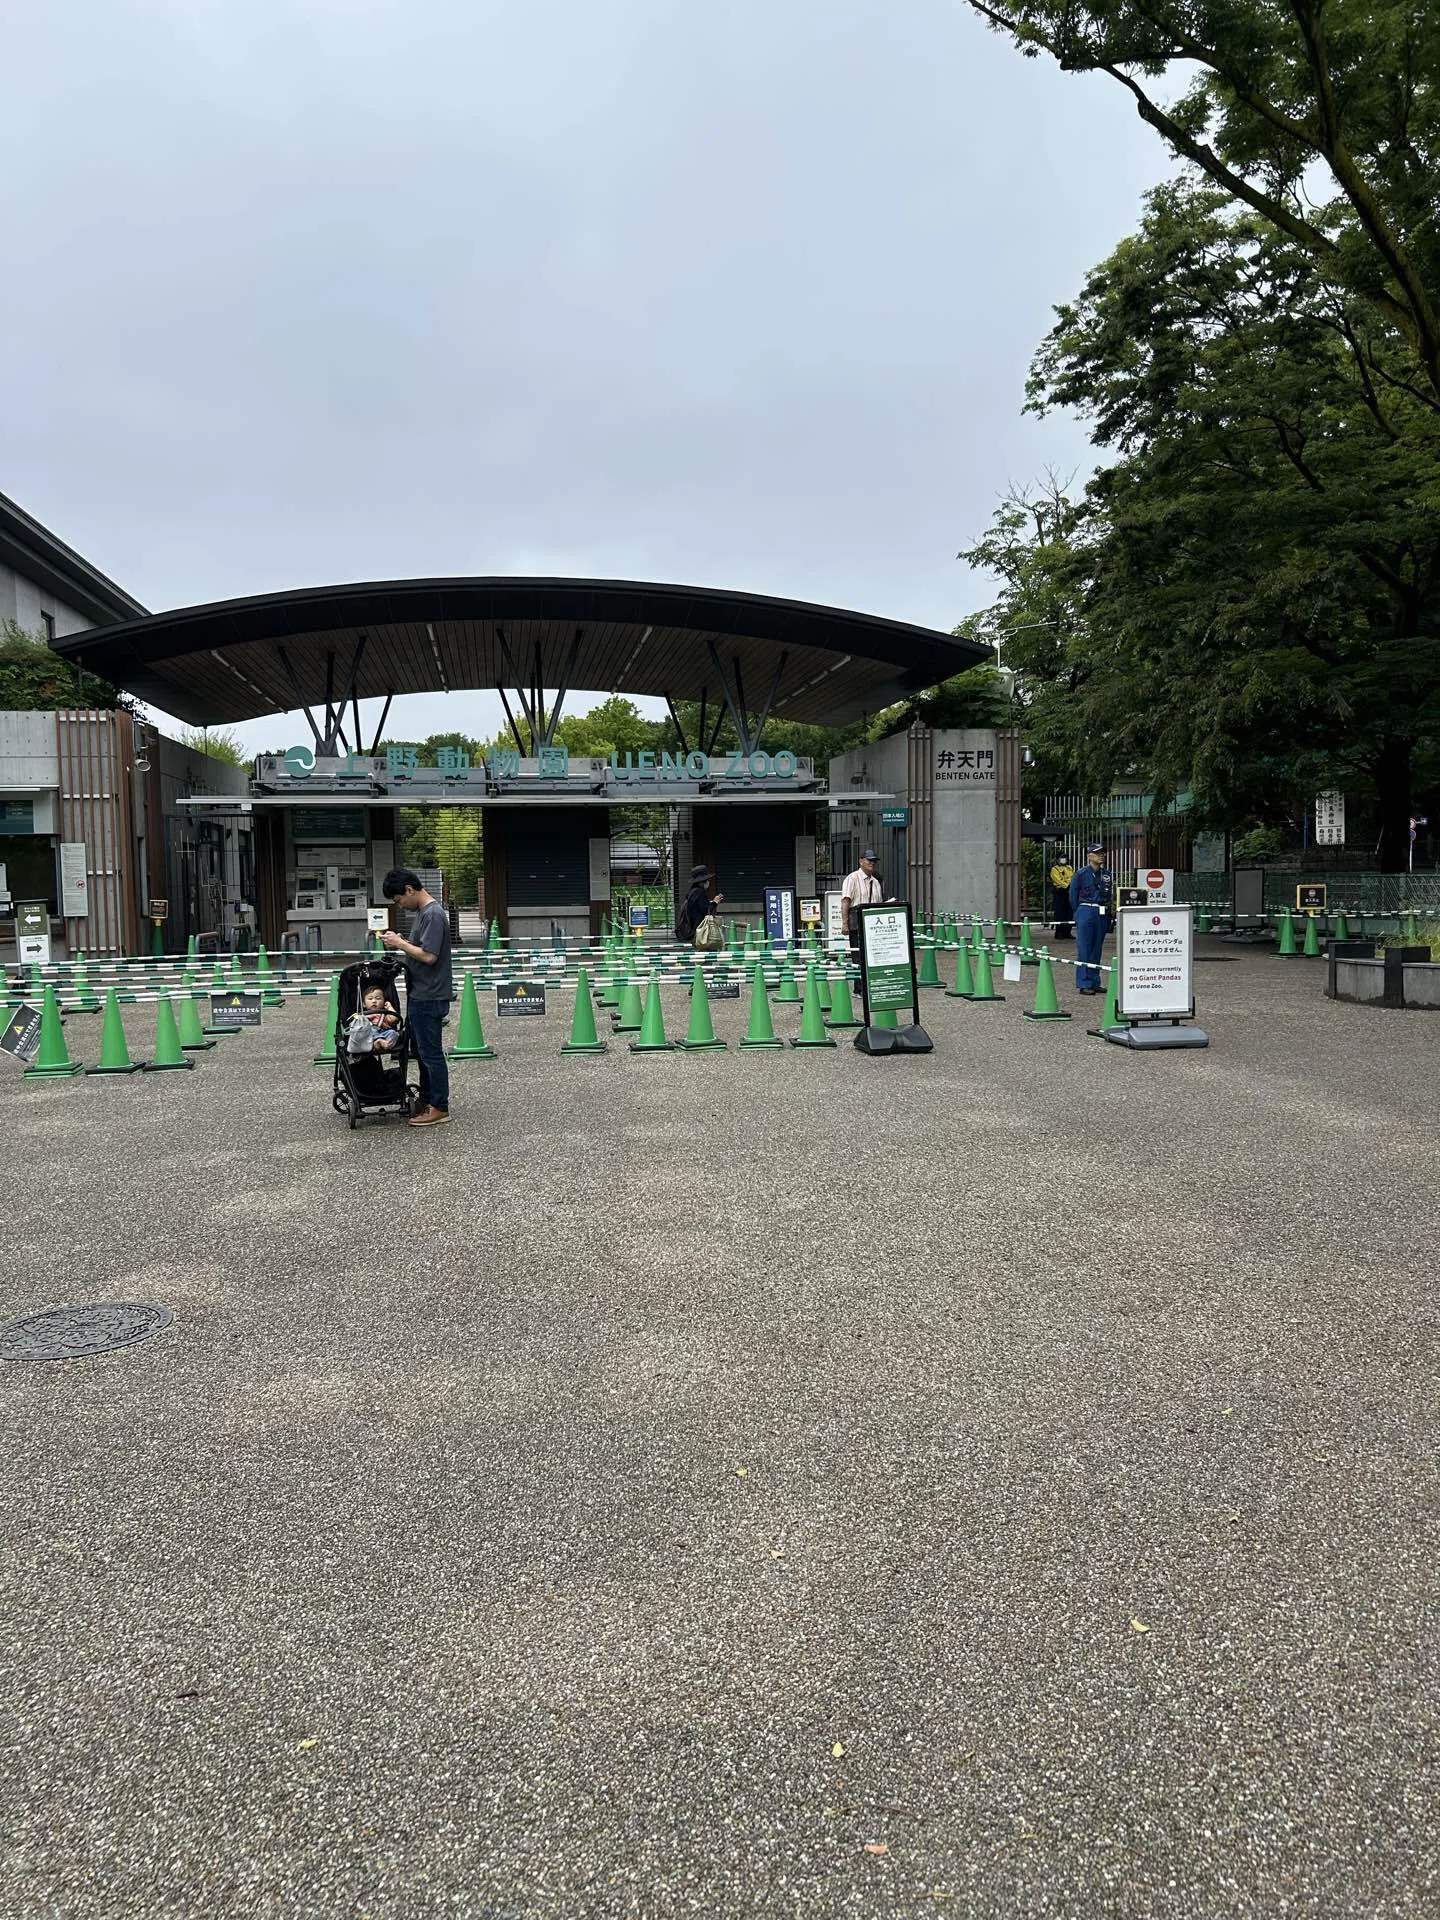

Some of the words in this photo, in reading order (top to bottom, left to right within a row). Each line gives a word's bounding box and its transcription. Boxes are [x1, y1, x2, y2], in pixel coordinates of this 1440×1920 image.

[335, 746, 569, 779] 上野動物園
[611, 750, 710, 779] UENO
[725, 750, 797, 778] ZOO
[938, 750, 993, 768] 弁天門
[936, 772, 970, 780] BENTEN
[973, 772, 996, 780] GATE
[769, 895, 778, 924] 専用入口
[875, 916, 895, 925] 入口
